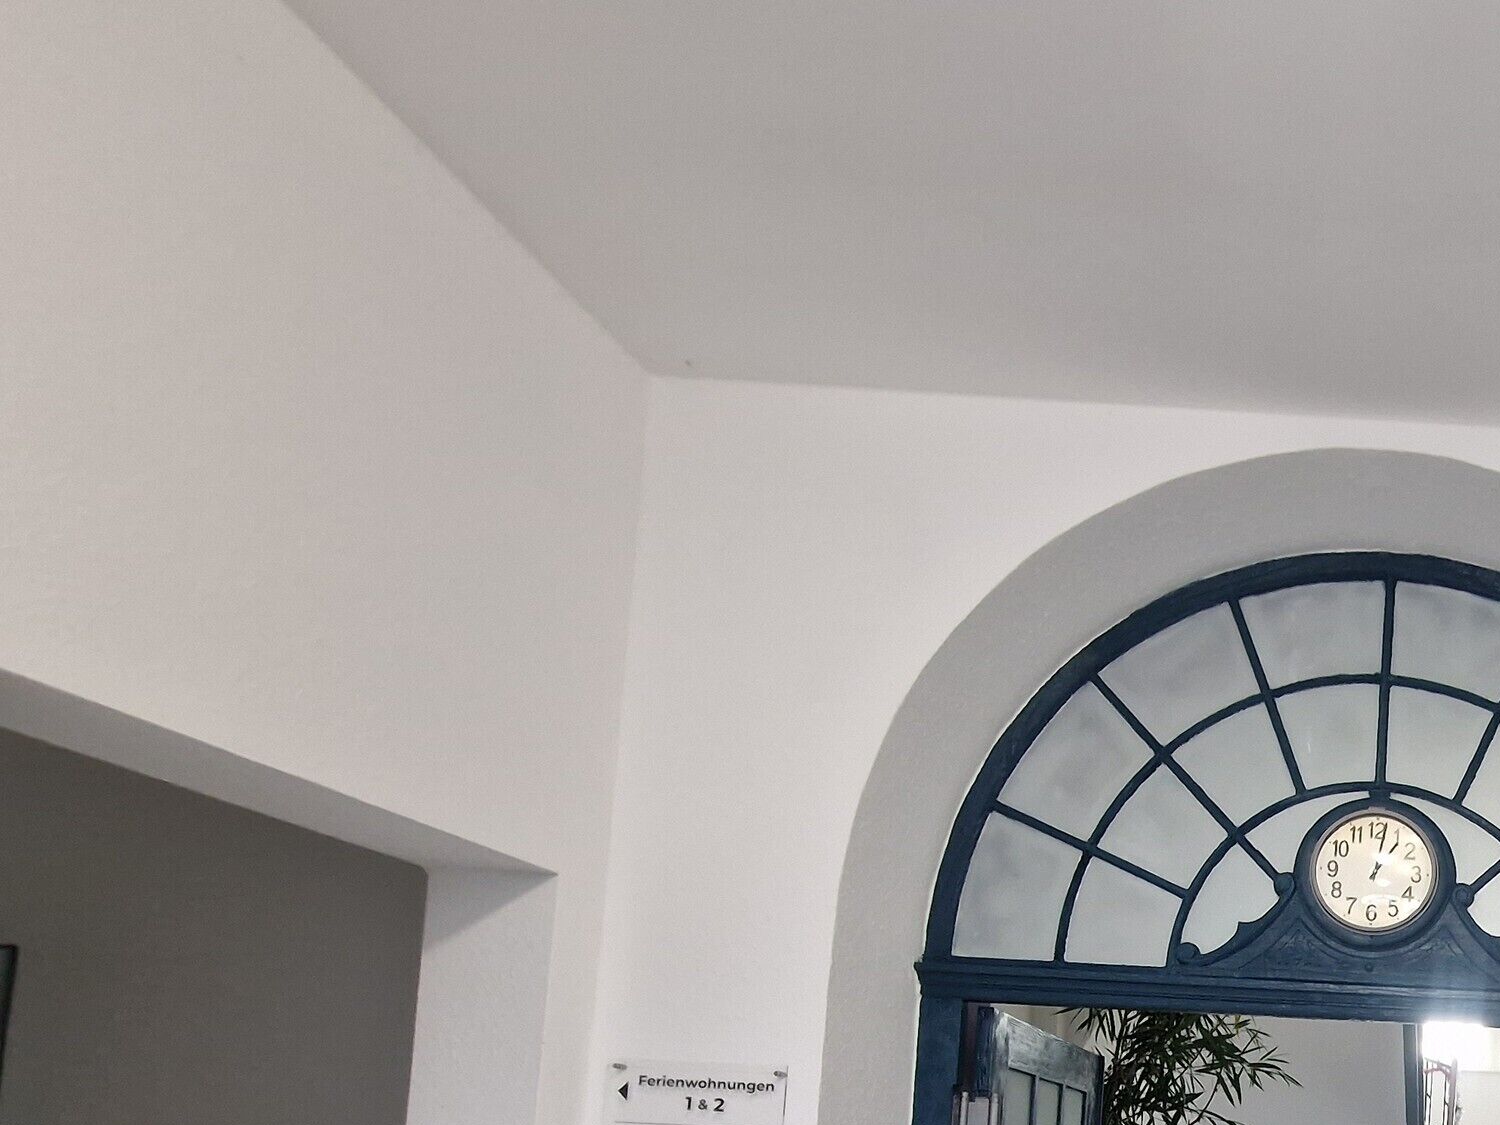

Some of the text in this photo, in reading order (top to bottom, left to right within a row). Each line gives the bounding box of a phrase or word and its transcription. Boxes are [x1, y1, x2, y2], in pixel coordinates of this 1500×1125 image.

[1349, 825, 1363, 843] 11
[1368, 821, 1385, 840] 12
[1332, 839, 1349, 857] 10
[1404, 842, 1416, 860] 2
[1327, 860, 1339, 877] 9
[1410, 866, 1422, 883] 3
[1331, 881, 1342, 898] 8
[1401, 886, 1414, 902] 4
[1346, 897, 1357, 914] 7
[1366, 904, 1377, 921] 6
[1388, 900, 1399, 917] 5
[638, 1075, 775, 1094] Ferienwohnungen
[685, 1096, 725, 1112] 1 & 2
